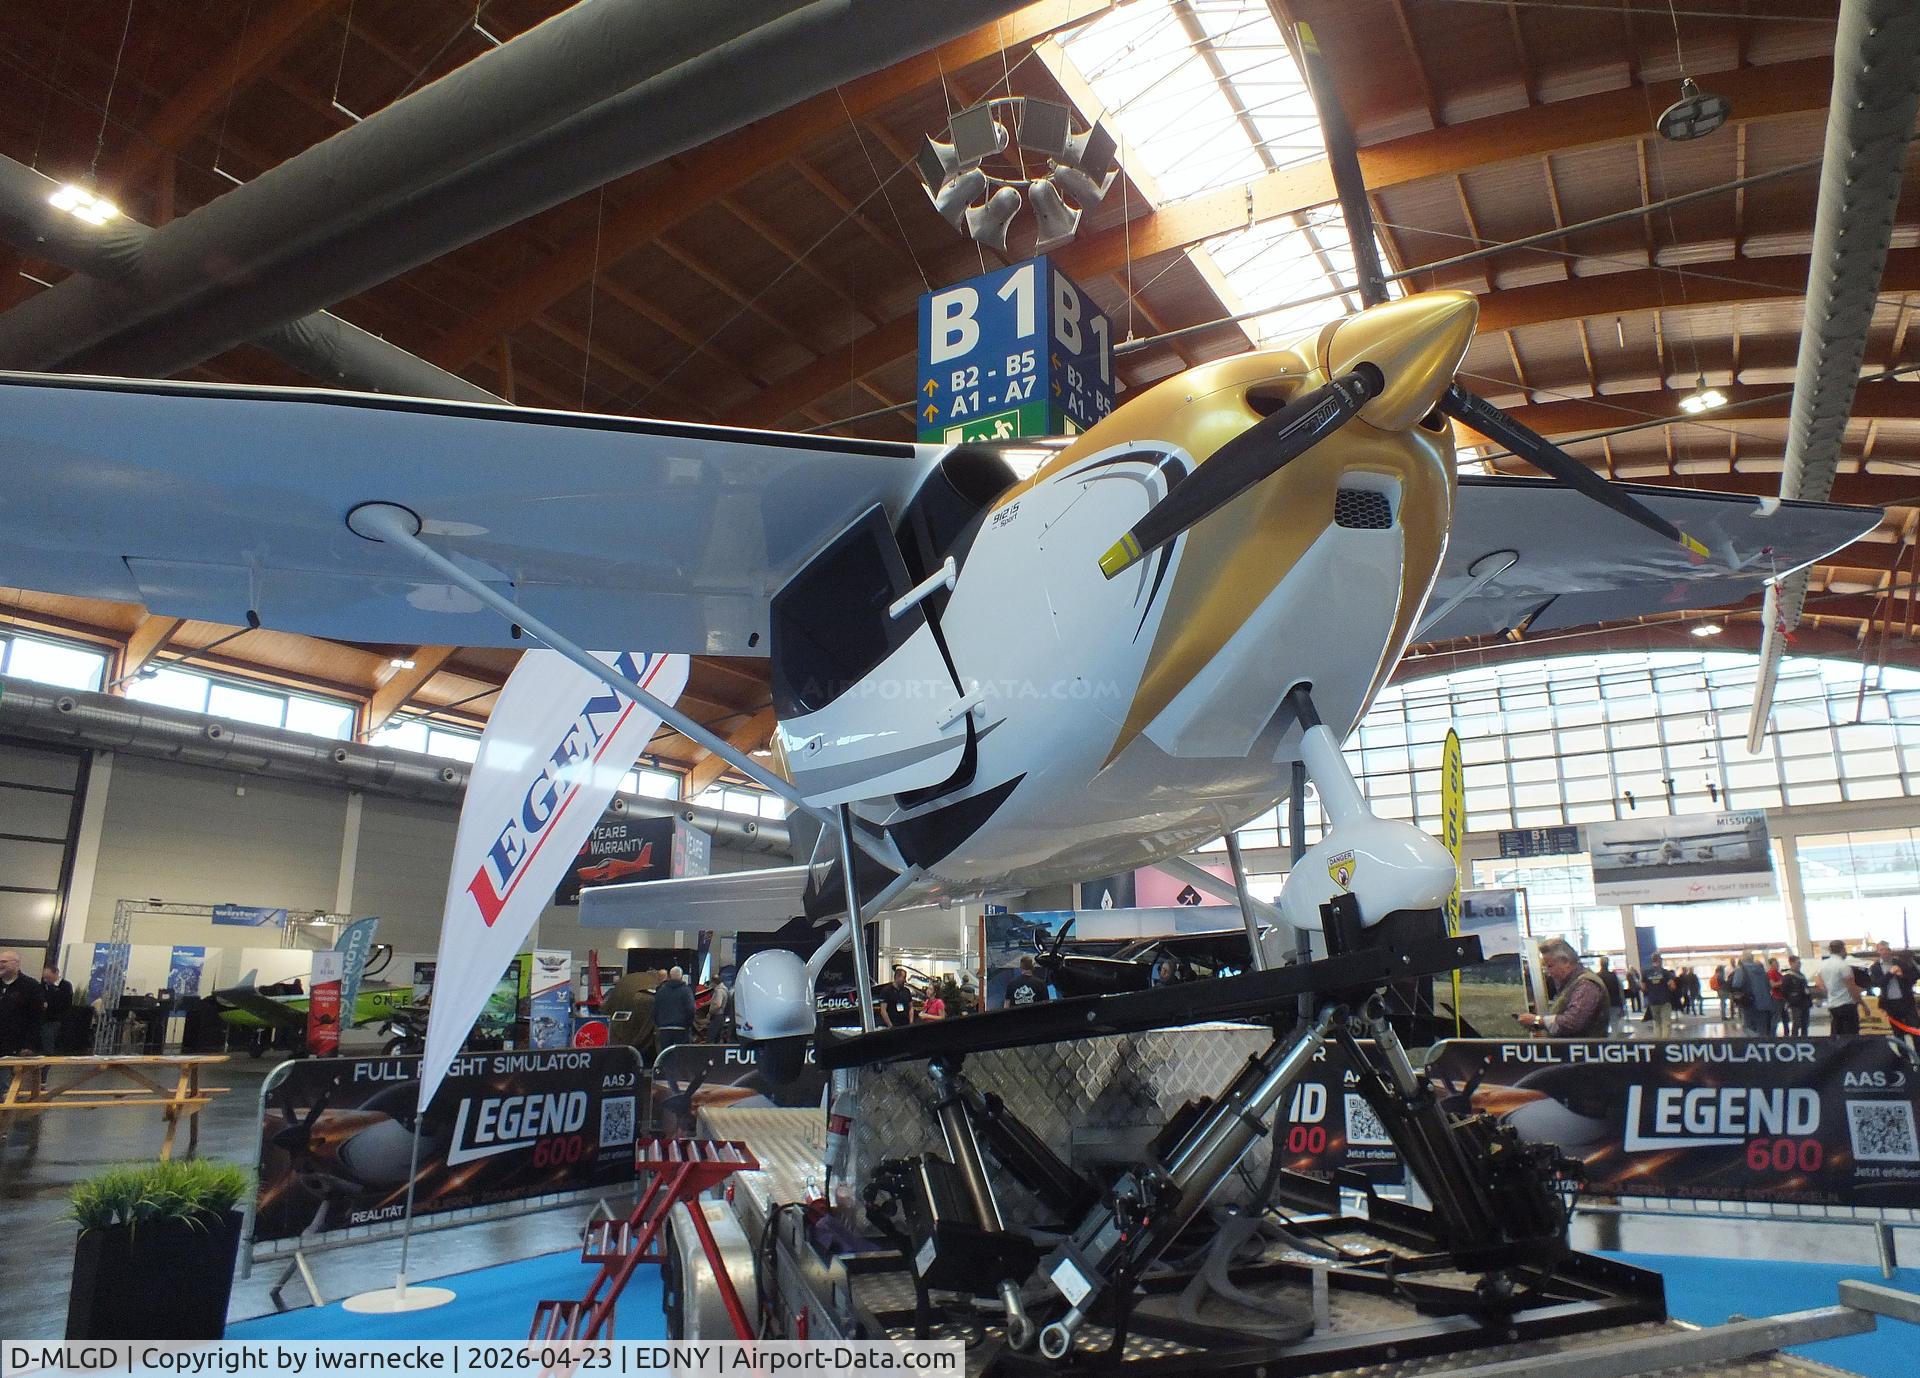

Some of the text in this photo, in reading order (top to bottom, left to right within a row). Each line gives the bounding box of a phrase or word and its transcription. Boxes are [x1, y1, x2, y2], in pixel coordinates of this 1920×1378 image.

[951, 366, 979, 392] B2
[1006, 349, 1036, 377] B5
[950, 390, 980, 418] A1
[1004, 375, 1037, 403] A7
[1067, 364, 1084, 393] B2
[1095, 388, 1112, 415] B5
[1067, 391, 1085, 421] A1
[593, 825, 628, 840] YEARS
[1716, 816, 1764, 826] MISSION
[590, 837, 644, 855] WARRANTY
[1329, 851, 1353, 866] DANGER
[1707, 883, 1736, 892] FLIGHT
[1463, 900, 1506, 918] L.eu
[1501, 1043, 1816, 1064] FULL FLIGHT SIMULATOR
[353, 1052, 593, 1083] FULL FGHT SIMULATOR
[1843, 1070, 1886, 1088] AAS
[602, 1073, 626, 1088] AAS
[447, 1089, 588, 1168] LEGEND
[1624, 1084, 1821, 1153] LEGEND
[533, 1135, 583, 1169] 600
[1285, 1125, 1327, 1154] 00
[1746, 1138, 1823, 1172] 600
[350, 1203, 404, 1224] REALITÄT
